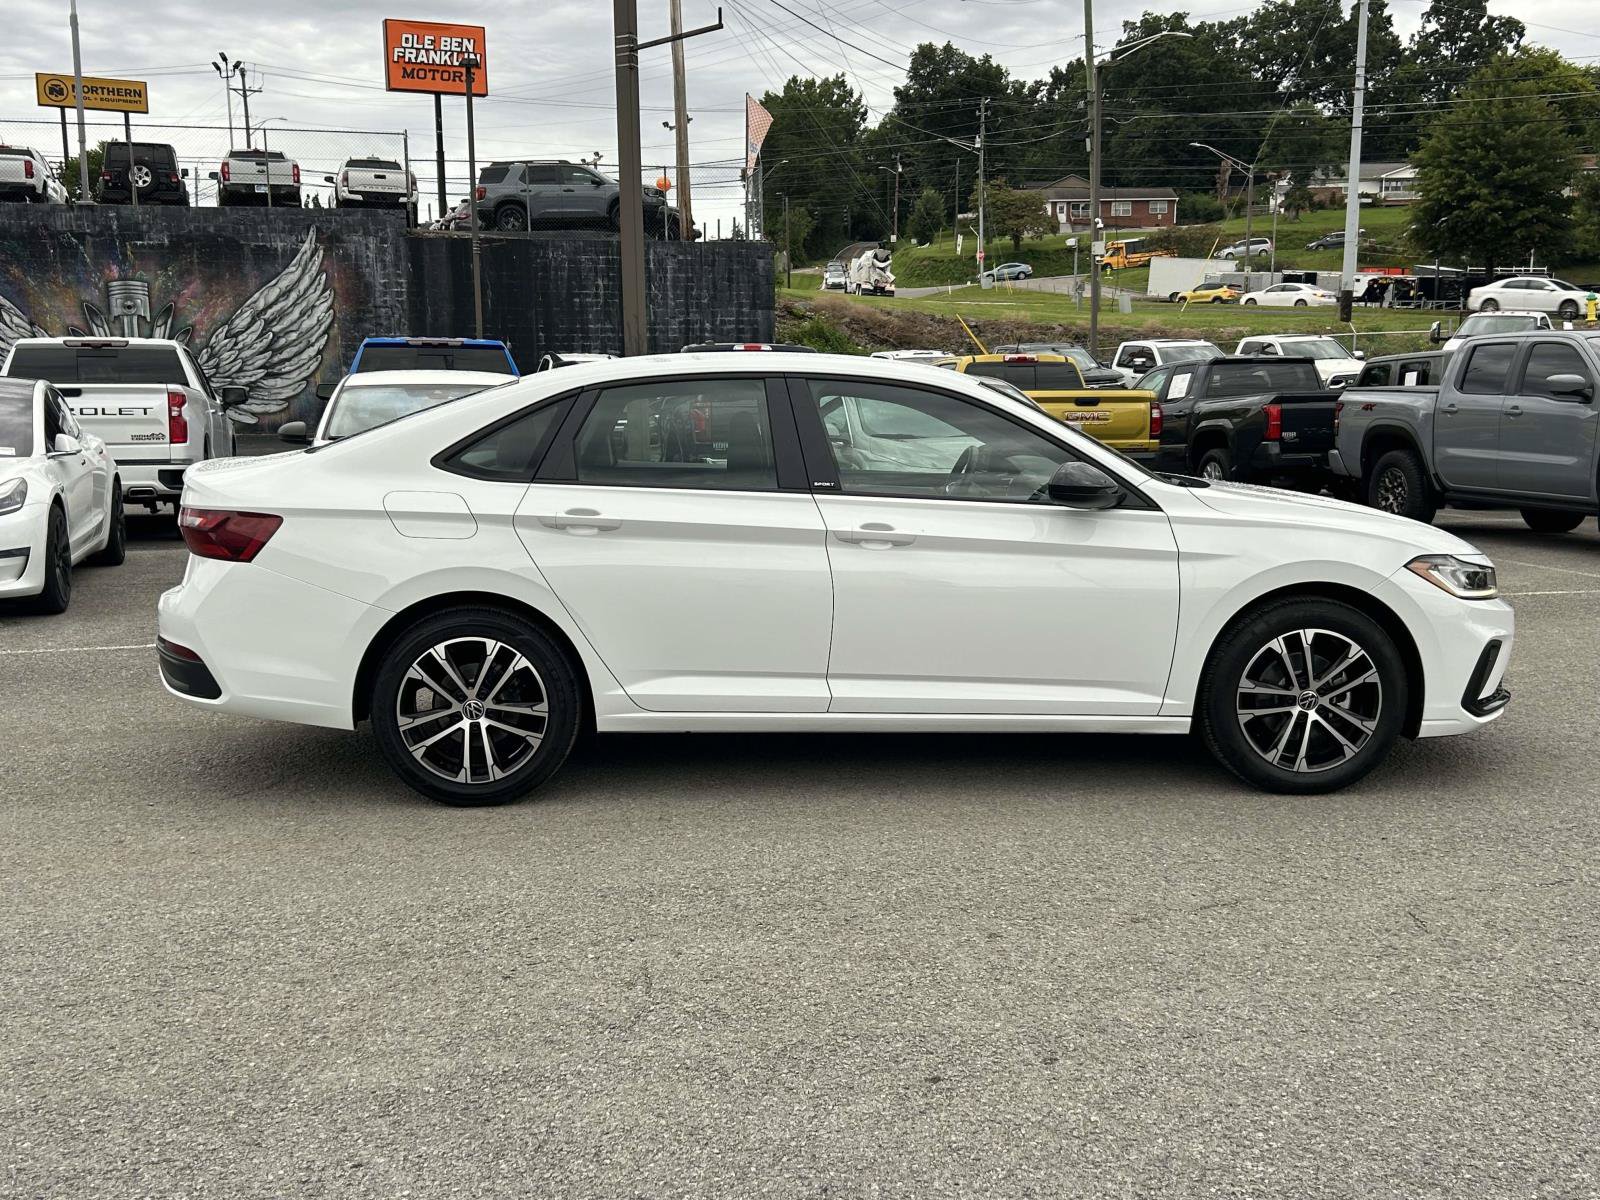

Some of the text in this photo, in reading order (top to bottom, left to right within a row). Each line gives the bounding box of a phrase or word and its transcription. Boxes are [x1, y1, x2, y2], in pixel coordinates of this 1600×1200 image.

[401, 33, 475, 53] OLE BEN
[1065, 411, 1111, 421] GMC
